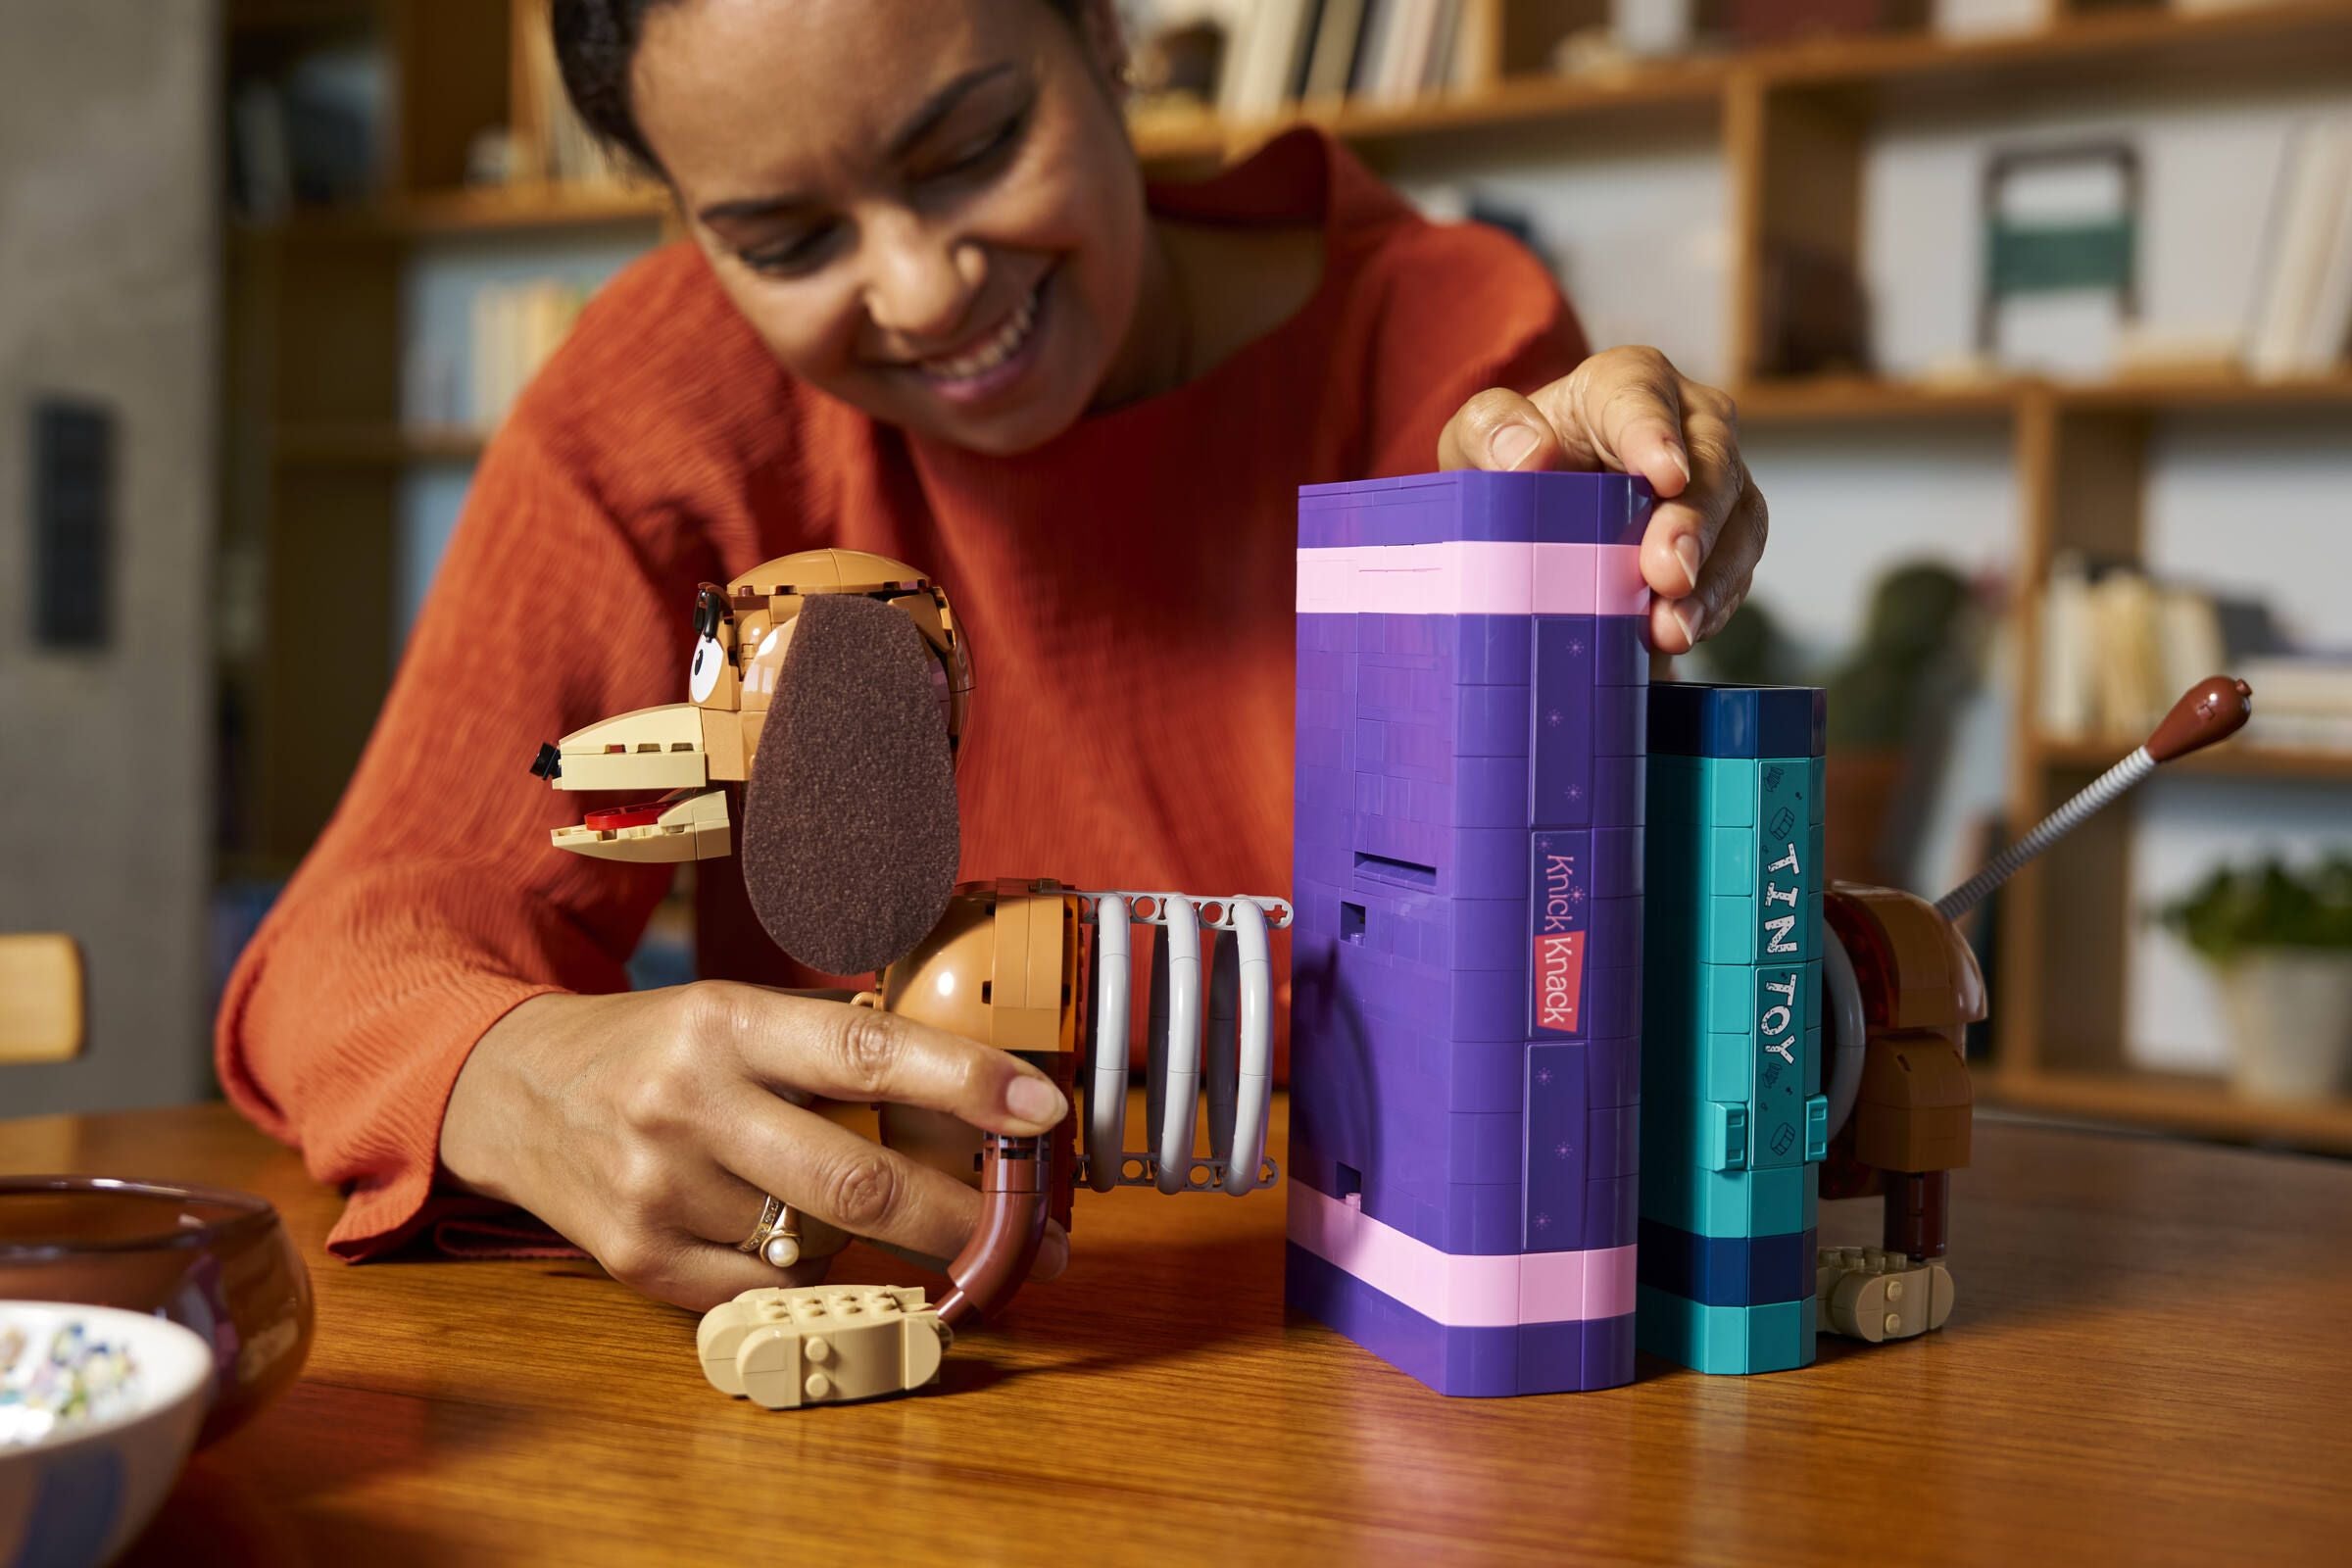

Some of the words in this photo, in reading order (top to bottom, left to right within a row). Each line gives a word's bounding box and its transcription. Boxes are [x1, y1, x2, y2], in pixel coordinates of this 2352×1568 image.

[1544, 855, 1574, 931] Knick
[1765, 842, 1800, 954] TIN
[1544, 937, 1572, 1023] Knack
[1761, 973, 1797, 1065] TOY
